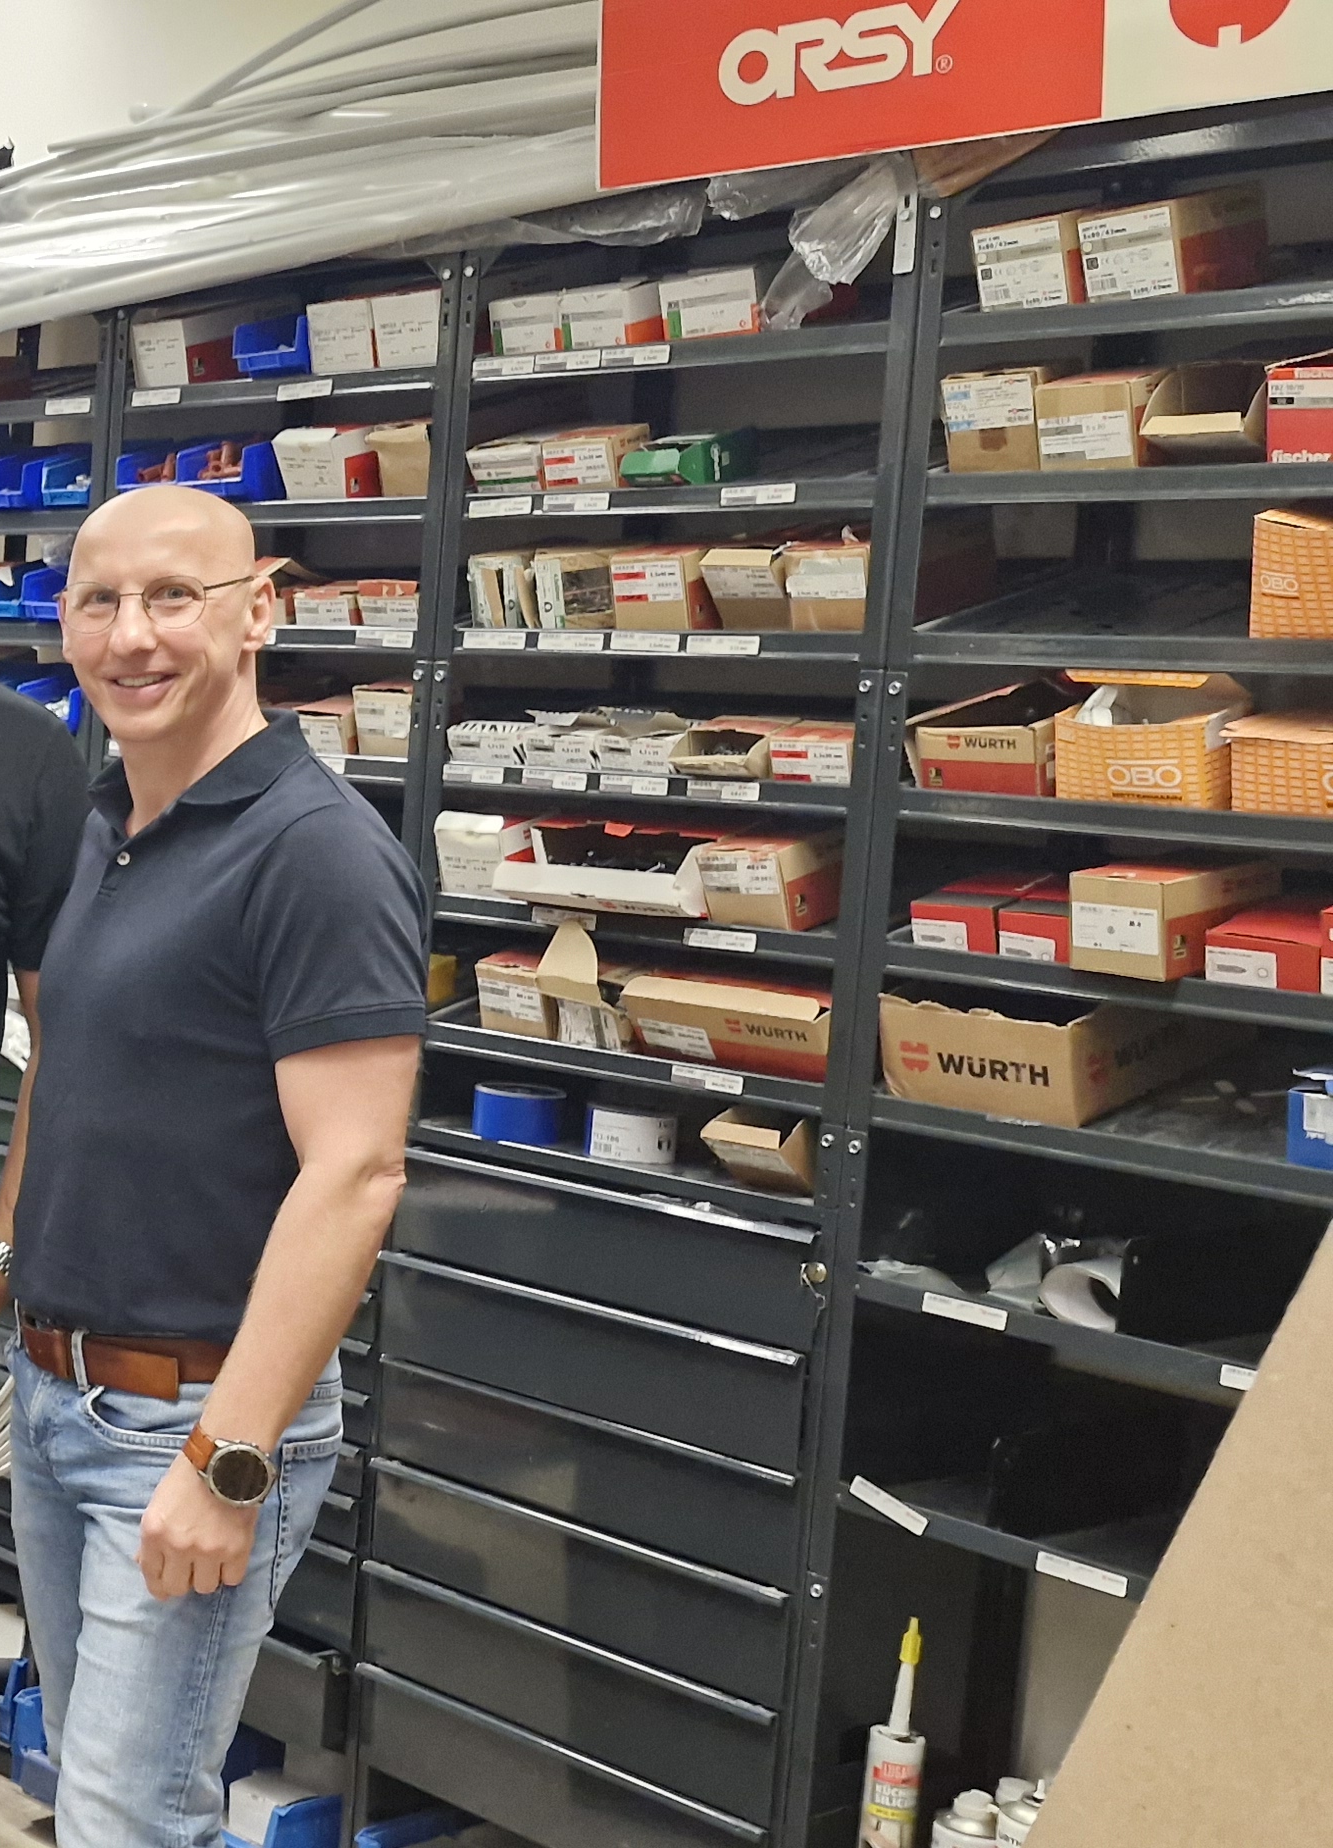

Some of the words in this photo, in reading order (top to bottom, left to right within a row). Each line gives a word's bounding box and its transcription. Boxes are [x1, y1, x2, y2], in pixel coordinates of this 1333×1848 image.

[718, 0, 960, 106] ORSY
[1260, 574, 1299, 592] OBO
[1107, 765, 1182, 787] OBO
[937, 1052, 1050, 1088] WÜRTH
